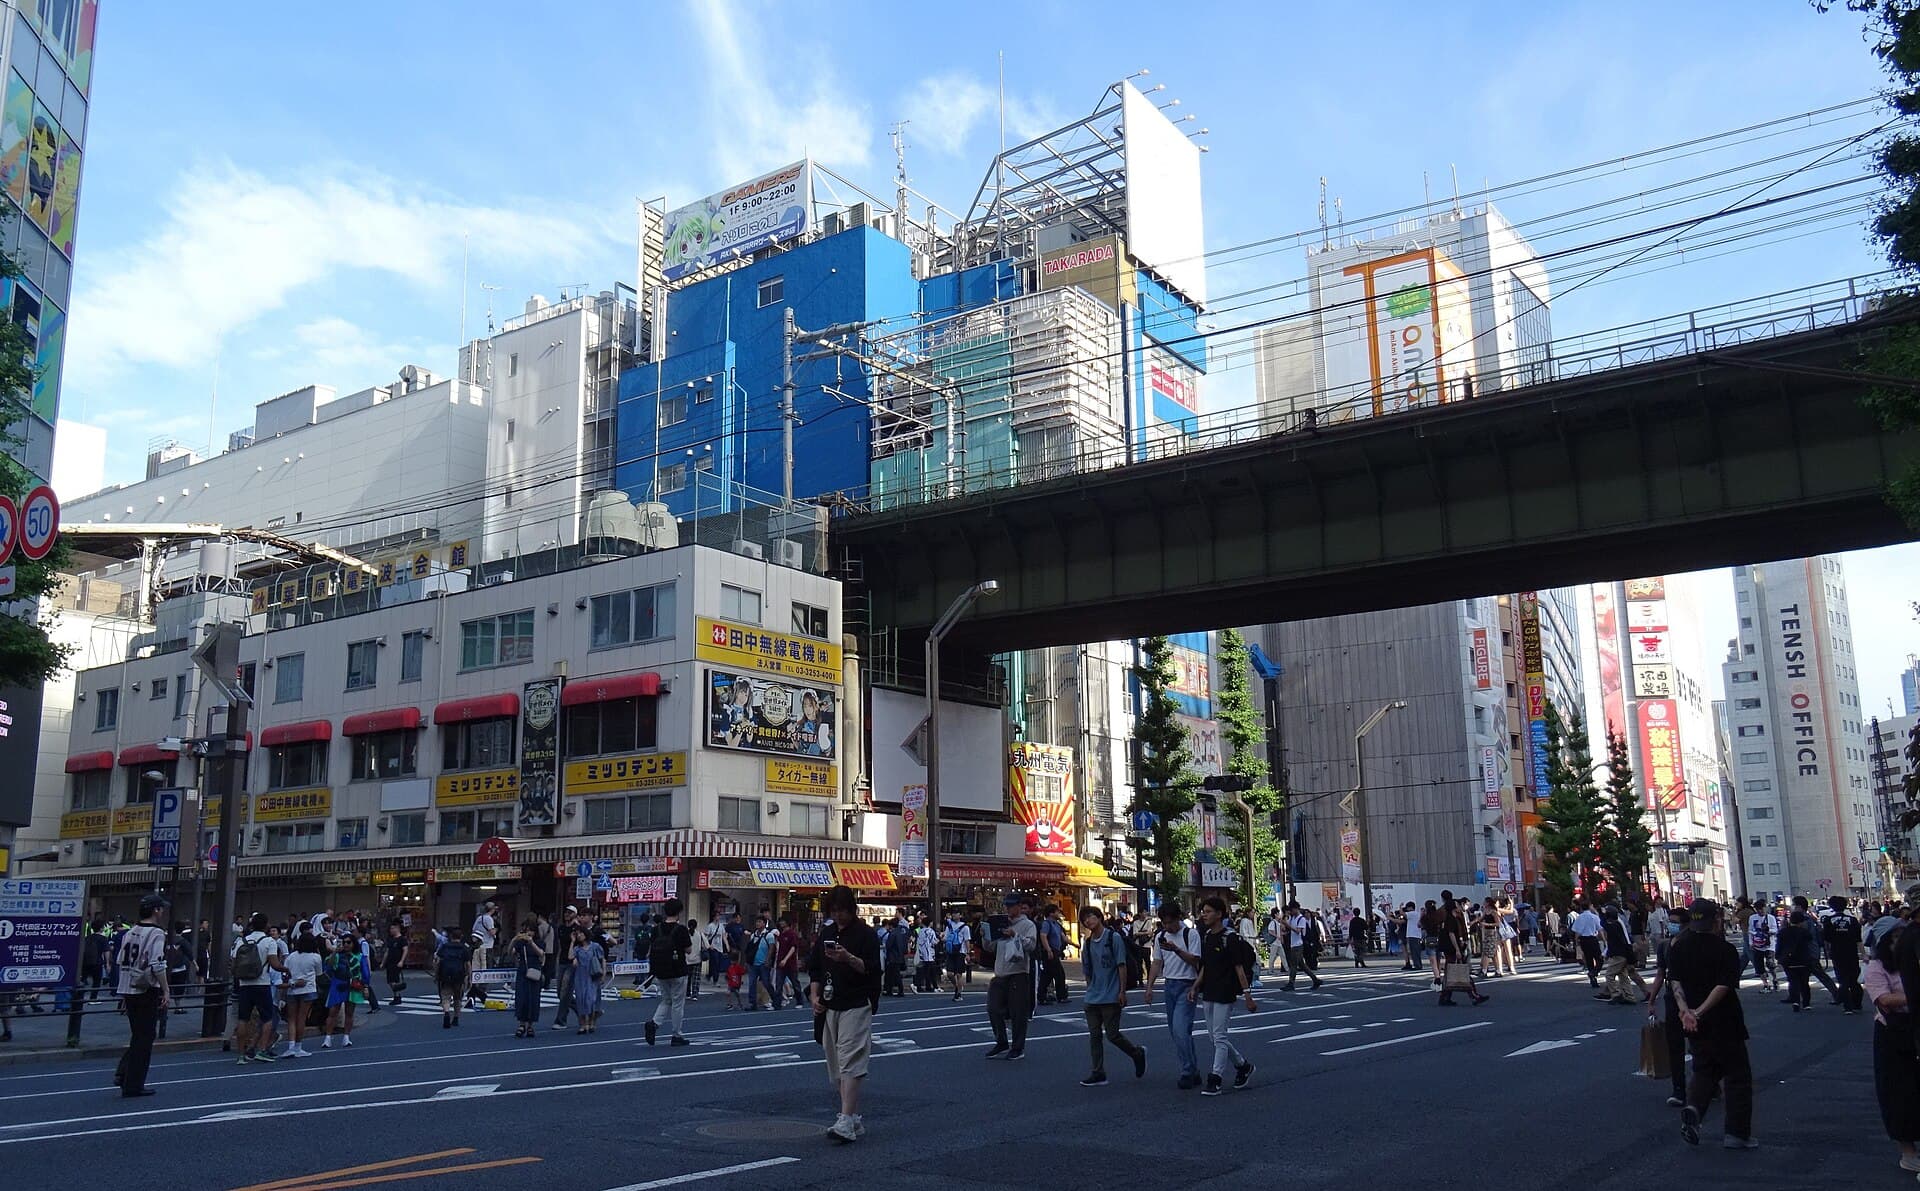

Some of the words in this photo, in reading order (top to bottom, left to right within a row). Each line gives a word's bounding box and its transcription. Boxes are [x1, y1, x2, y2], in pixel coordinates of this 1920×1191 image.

[721, 165, 803, 206] GAMERS
[729, 206, 740, 216] 1F
[1044, 245, 1114, 275] TAKARADA
[28, 506, 50, 538] 50
[253, 546, 466, 612] 秋葉原電波会館
[785, 665, 795, 674] TEL
[1476, 638, 1488, 680] FIGURE
[1529, 685, 1544, 717] DVD
[1790, 693, 1818, 776] OFFICE
[588, 757, 673, 780] ミツワデンキ
[1014, 749, 1071, 774] 九州電気
[1485, 748, 1494, 790] amiami
[450, 775, 517, 793] ミツワデンキ
[778, 769, 828, 785] タイガー無線
[158, 794, 178, 823] P
[164, 842, 179, 857] IN
[758, 871, 787, 884] COIN
[789, 872, 832, 885] LOCKER
[841, 868, 892, 886] ANIME
[15, 923, 78, 931] 千代田区エリアマップ
[23, 968, 56, 976] 中央通り
